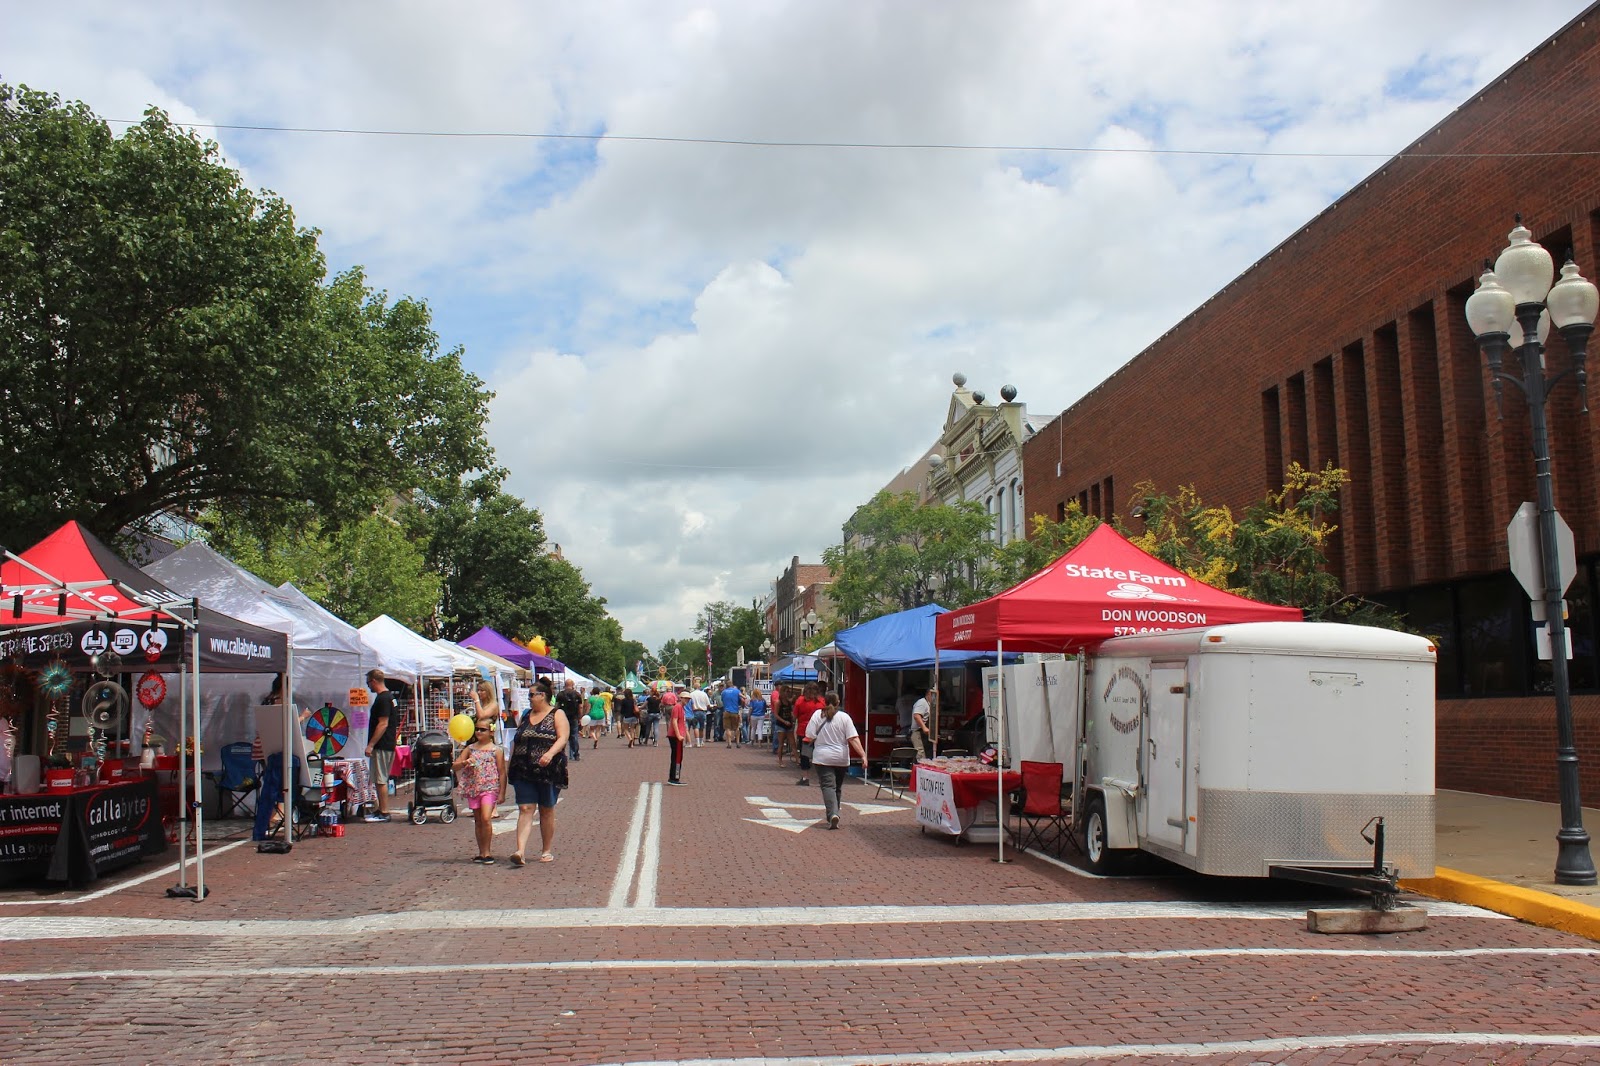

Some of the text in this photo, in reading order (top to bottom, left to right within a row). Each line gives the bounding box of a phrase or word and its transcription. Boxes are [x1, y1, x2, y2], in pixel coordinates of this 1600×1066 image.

[1101, 609, 1207, 625] DON WOODSON
[209, 636, 272, 661] www.callabyte.com
[10, 802, 62, 821] internet
[89, 796, 147, 826] callabyte
